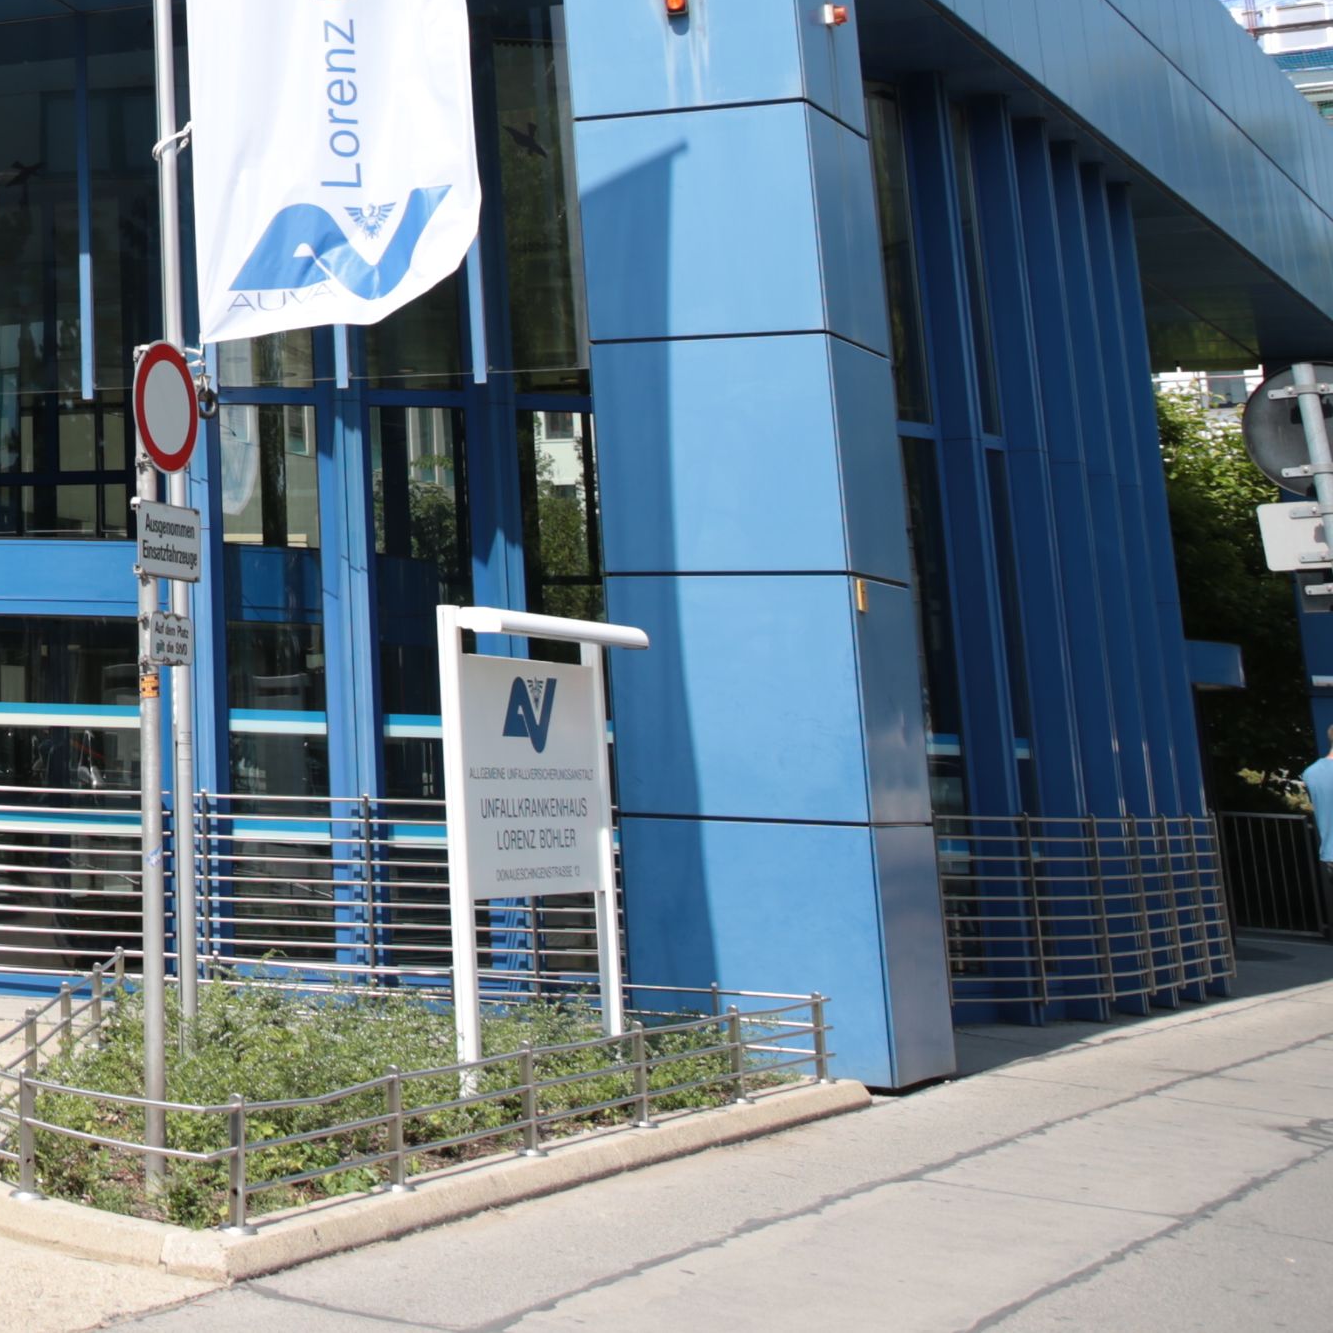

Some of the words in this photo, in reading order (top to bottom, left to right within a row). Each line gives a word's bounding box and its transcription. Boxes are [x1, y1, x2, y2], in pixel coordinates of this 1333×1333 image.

[320, 18, 363, 189] Lorenz
[226, 282, 338, 313] AUVA
[144, 512, 196, 540] Ausgenommen
[141, 539, 199, 571] Einsatzfahrzeuge
[154, 621, 165, 635] Auf
[165, 623, 176, 637] dem
[176, 624, 189, 639] Platz
[155, 639, 165, 654] gilt
[166, 641, 174, 654] die
[468, 766, 506, 781] ALLGEMEINE
[480, 796, 588, 819] UNFALLKRANKENHAUS
[496, 829, 536, 851] LORENZ
[539, 827, 577, 850] BÖHLER
[495, 865, 573, 882] DONAUESCHINGENSTRASSE
